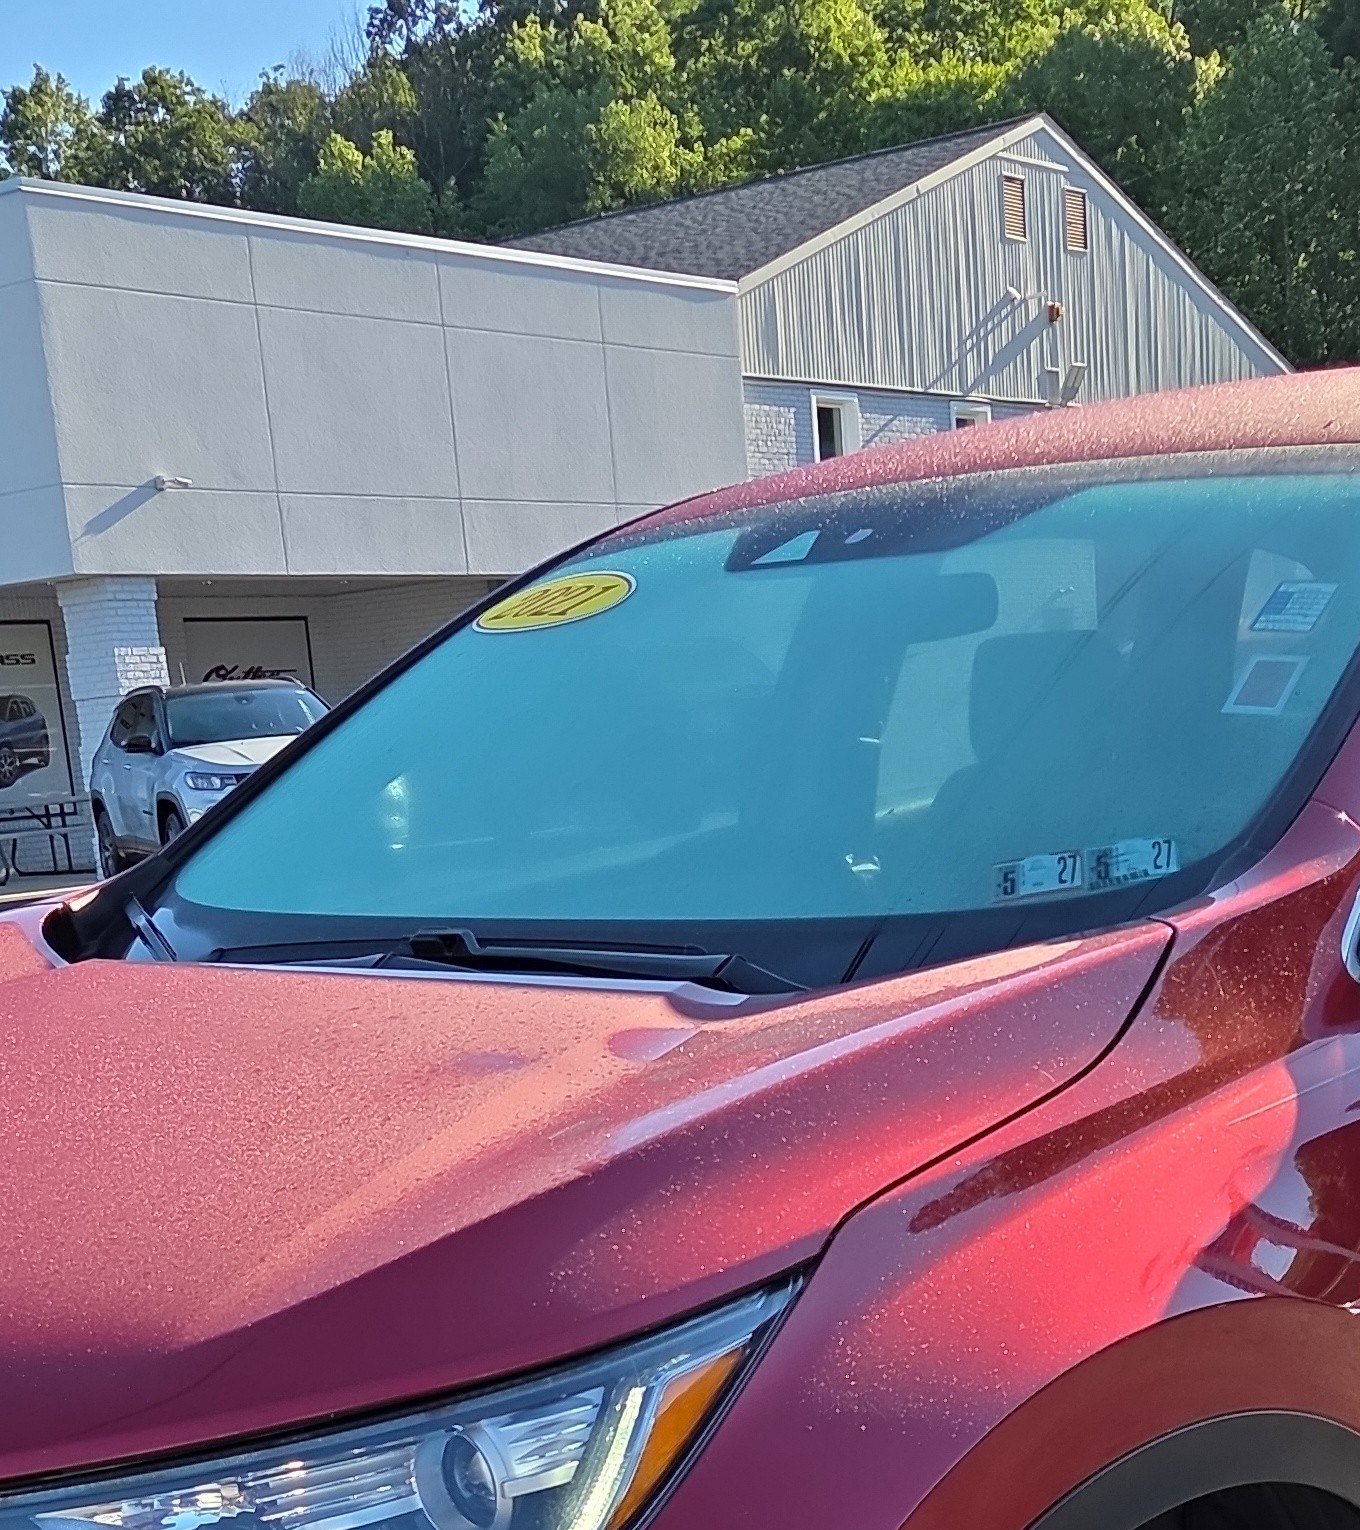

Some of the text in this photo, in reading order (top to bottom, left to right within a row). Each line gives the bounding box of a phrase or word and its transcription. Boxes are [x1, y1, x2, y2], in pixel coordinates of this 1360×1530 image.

[487, 584, 621, 622] 2021
[1151, 839, 1172, 870] 27
[1002, 870, 1016, 896] 5
[1057, 855, 1078, 884] 27
